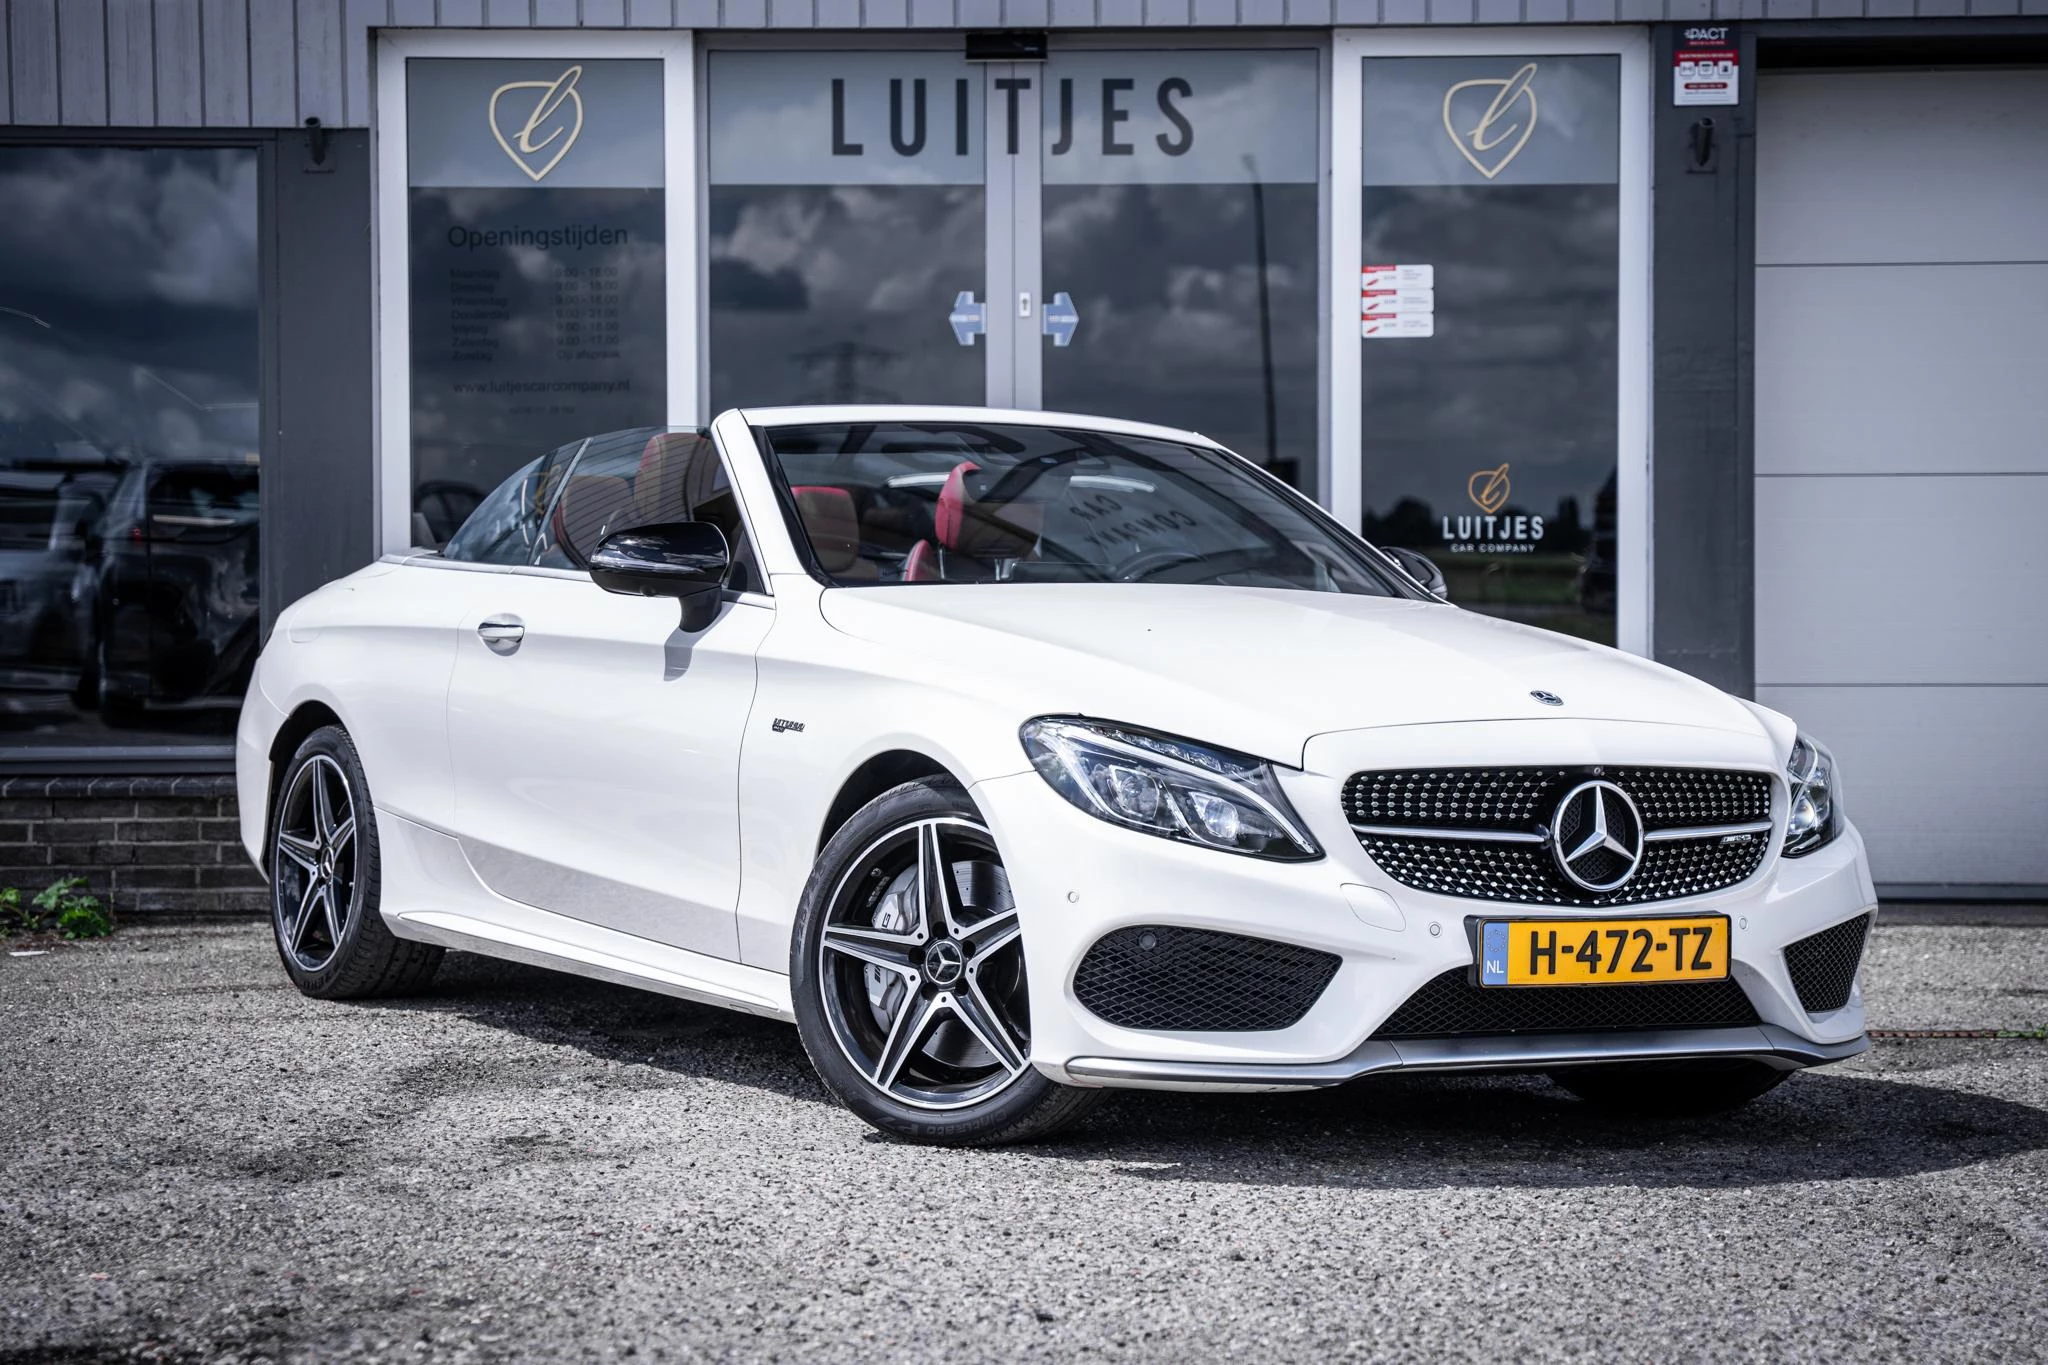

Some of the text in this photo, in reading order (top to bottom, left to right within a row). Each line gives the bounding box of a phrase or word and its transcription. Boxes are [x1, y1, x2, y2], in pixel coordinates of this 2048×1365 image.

[831, 77, 1194, 157] LUITJES
[447, 224, 628, 252] Openingstijden
[453, 378, 631, 395] www.luitjescarcompany.nl
[1442, 515, 1544, 540] LUITJES
[1450, 543, 1536, 552] CAR COMPANY
[1529, 926, 1713, 975] H-472-TZ
[1486, 960, 1505, 974] NL
